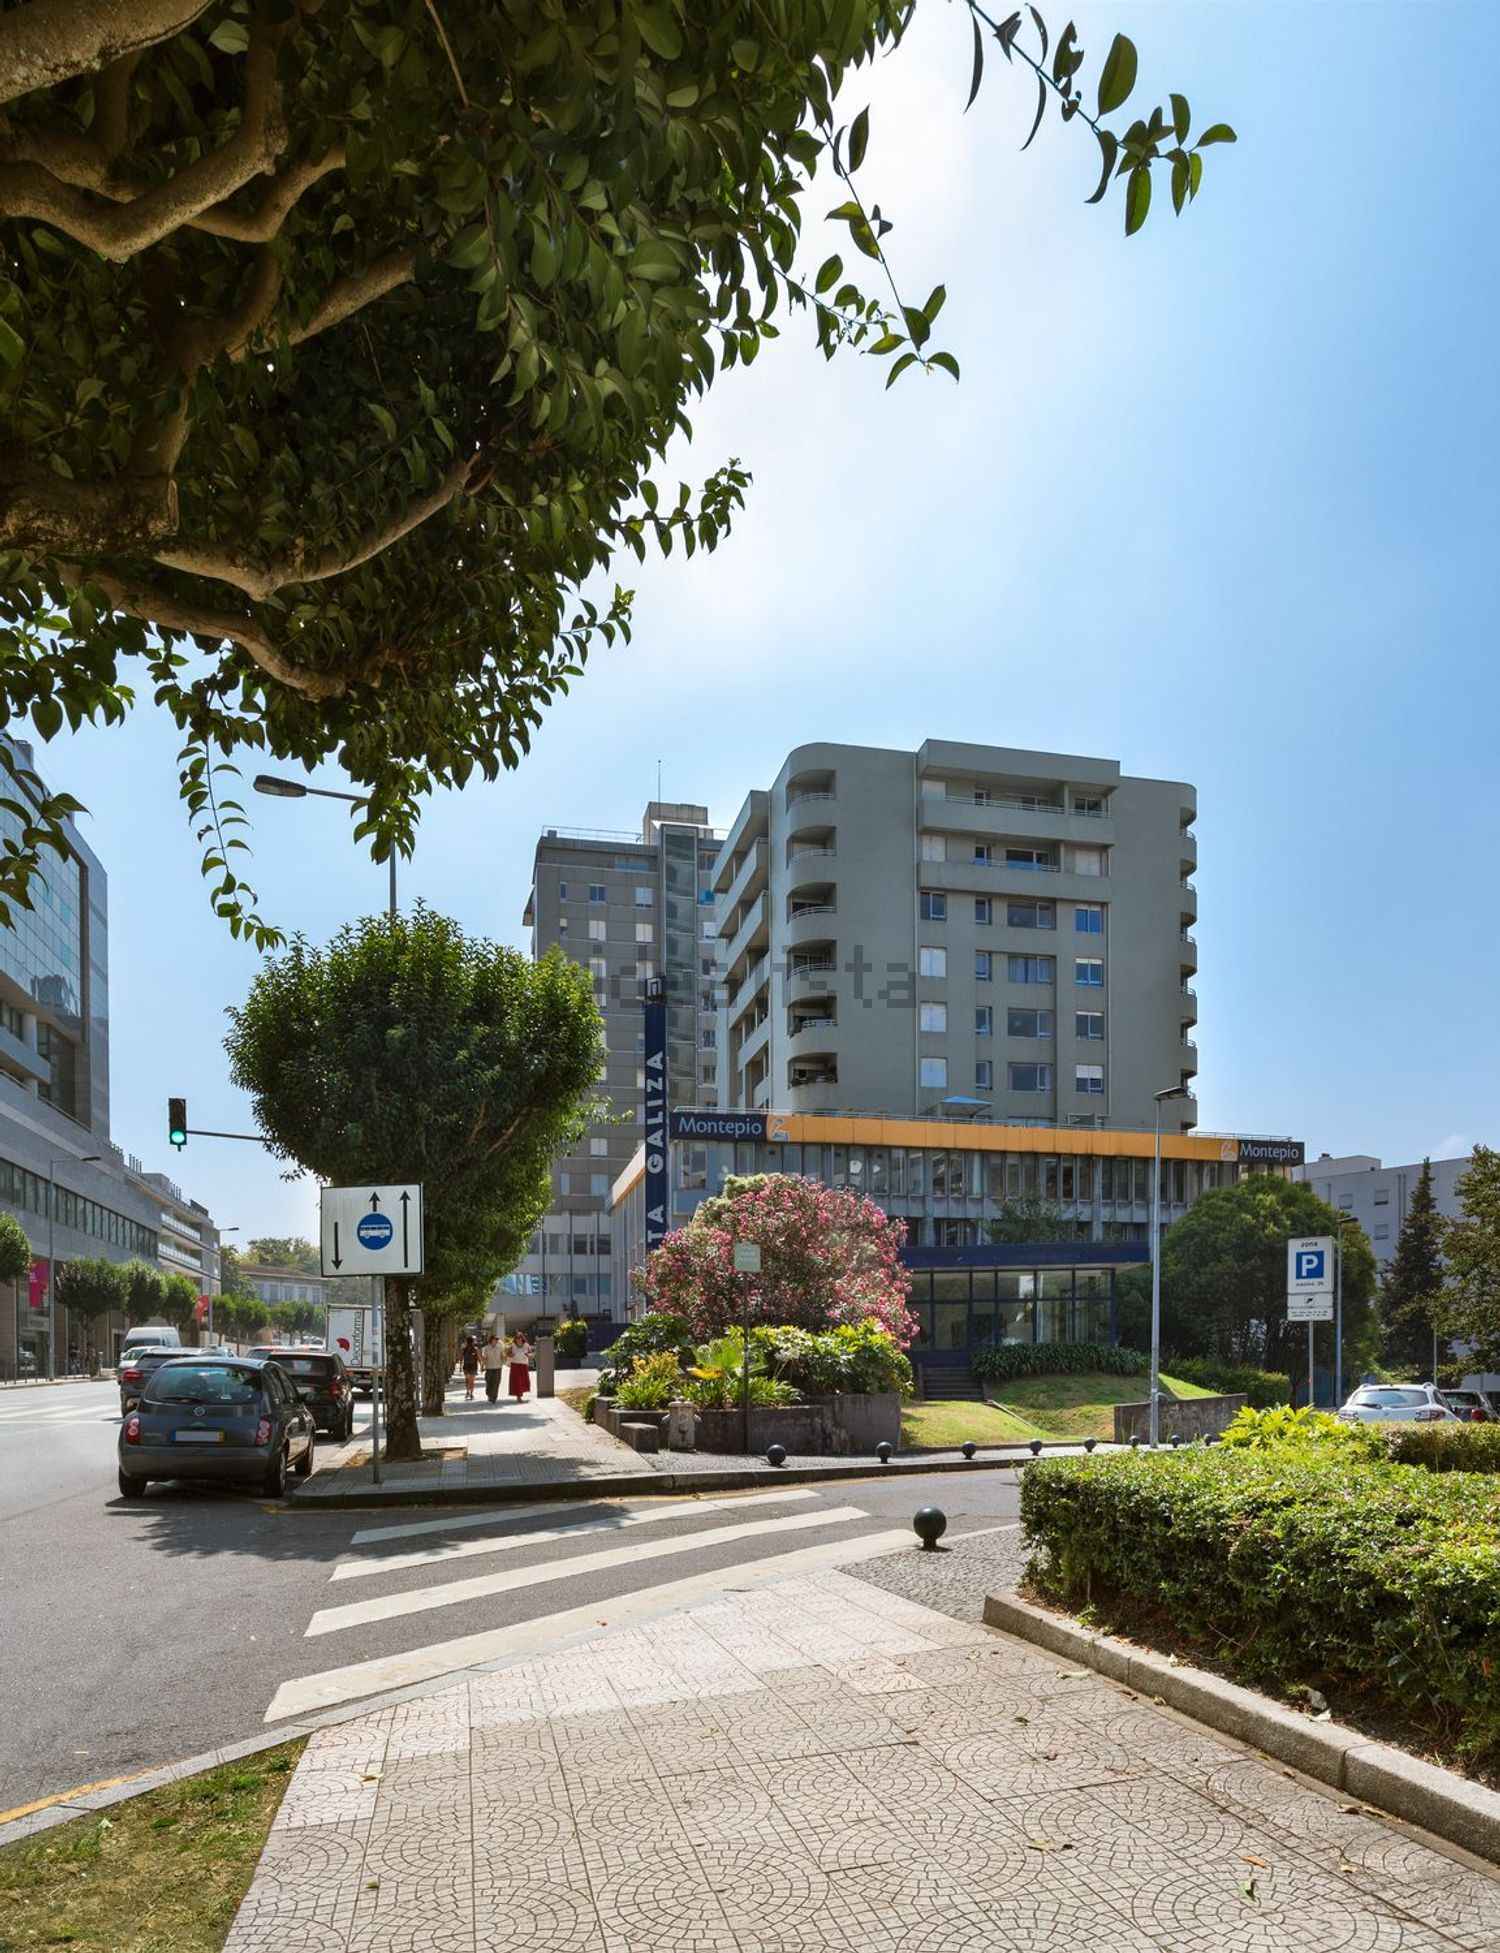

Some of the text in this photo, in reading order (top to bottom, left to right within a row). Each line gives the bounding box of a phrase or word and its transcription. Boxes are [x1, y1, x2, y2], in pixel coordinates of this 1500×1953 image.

[647, 1051, 664, 1174] GALIZA
[679, 1117, 761, 1138] Montepio
[1240, 1143, 1299, 1161] Montepio
[1301, 1254, 1319, 1277] P
